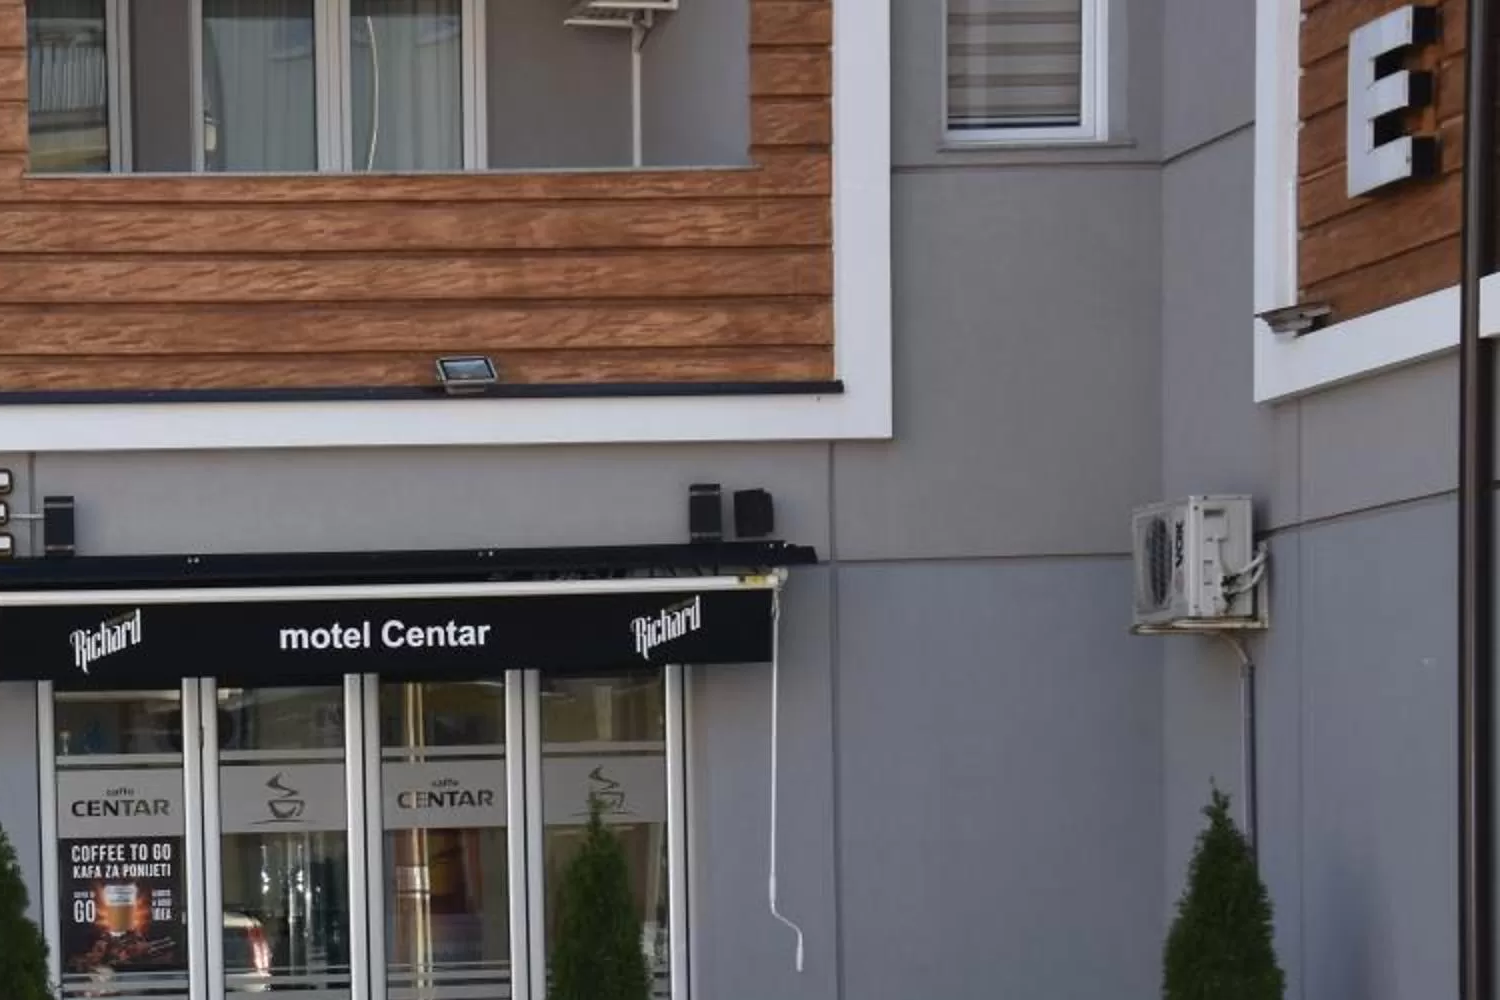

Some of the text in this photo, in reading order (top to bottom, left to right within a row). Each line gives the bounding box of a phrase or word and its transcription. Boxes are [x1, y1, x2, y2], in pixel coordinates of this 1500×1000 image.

[1348, 5, 1416, 198] E
[279, 618, 491, 650] motel Centar
[630, 595, 701, 660] Richard
[69, 607, 142, 674] Richard
[71, 799, 170, 817] CENTAR
[397, 789, 494, 809] CENTAR
[71, 843, 171, 862] COFFEE TO GO
[73, 863, 171, 879] KAFA ZA PONIJETI
[74, 899, 96, 923] GO
